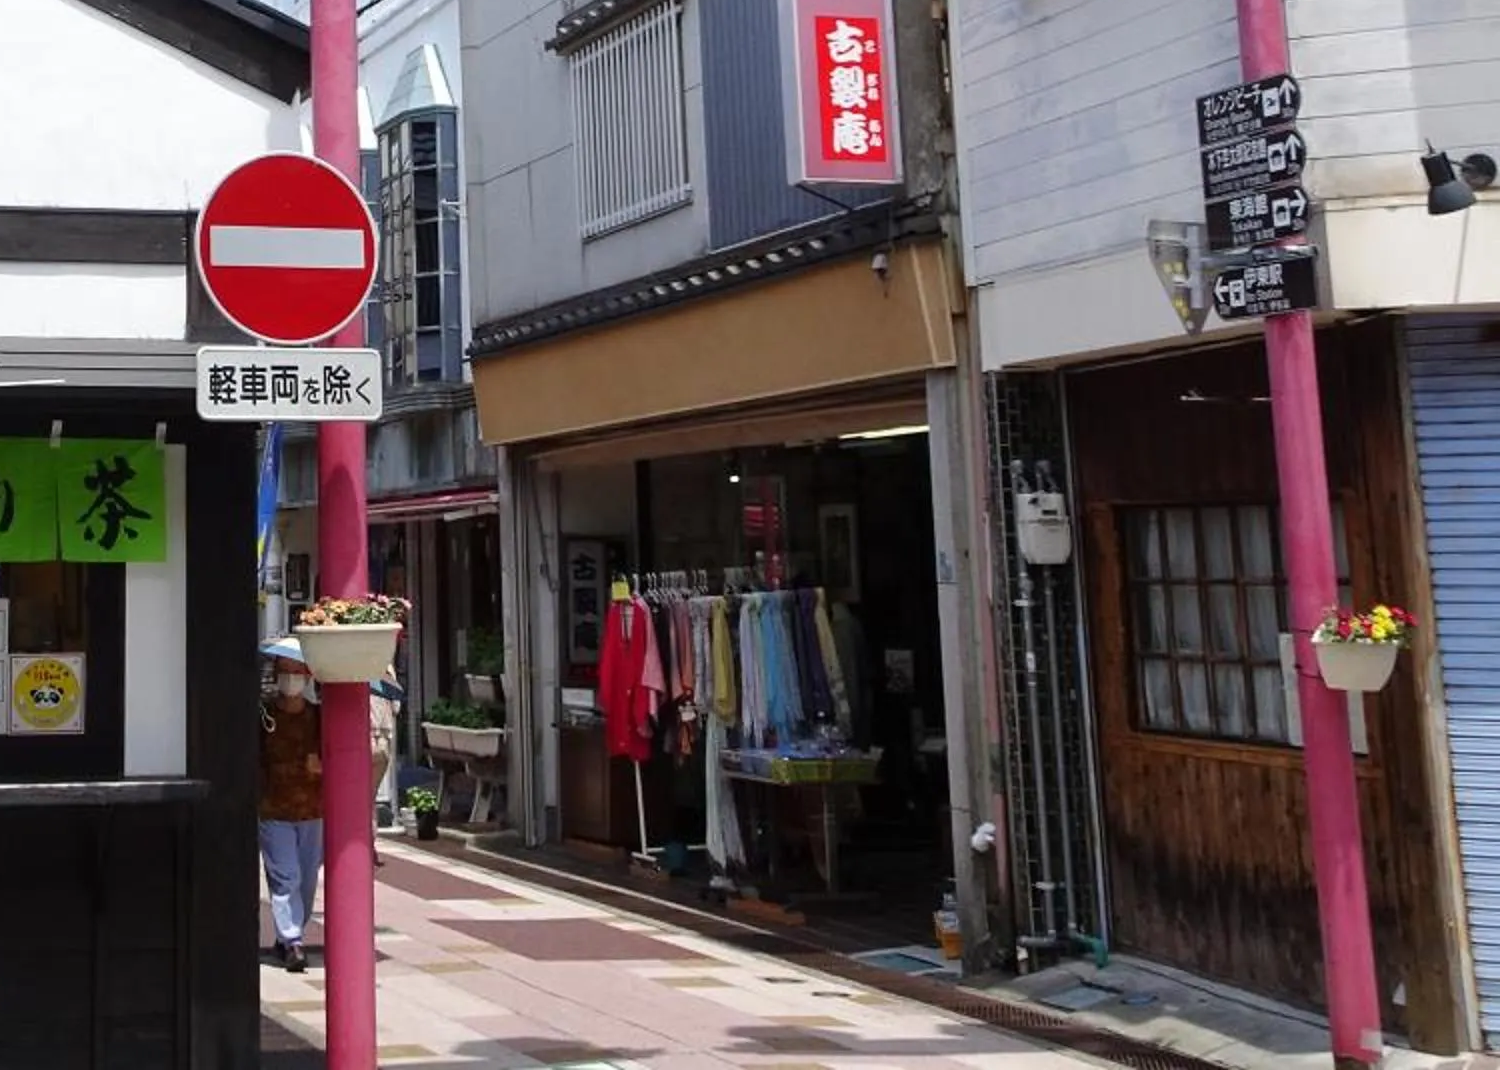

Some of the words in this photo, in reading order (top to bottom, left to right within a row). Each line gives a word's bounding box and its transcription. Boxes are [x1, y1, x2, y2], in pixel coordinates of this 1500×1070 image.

[1203, 84, 1263, 119] オレンジビーチ
[208, 365, 373, 407] 軽車両を除く
